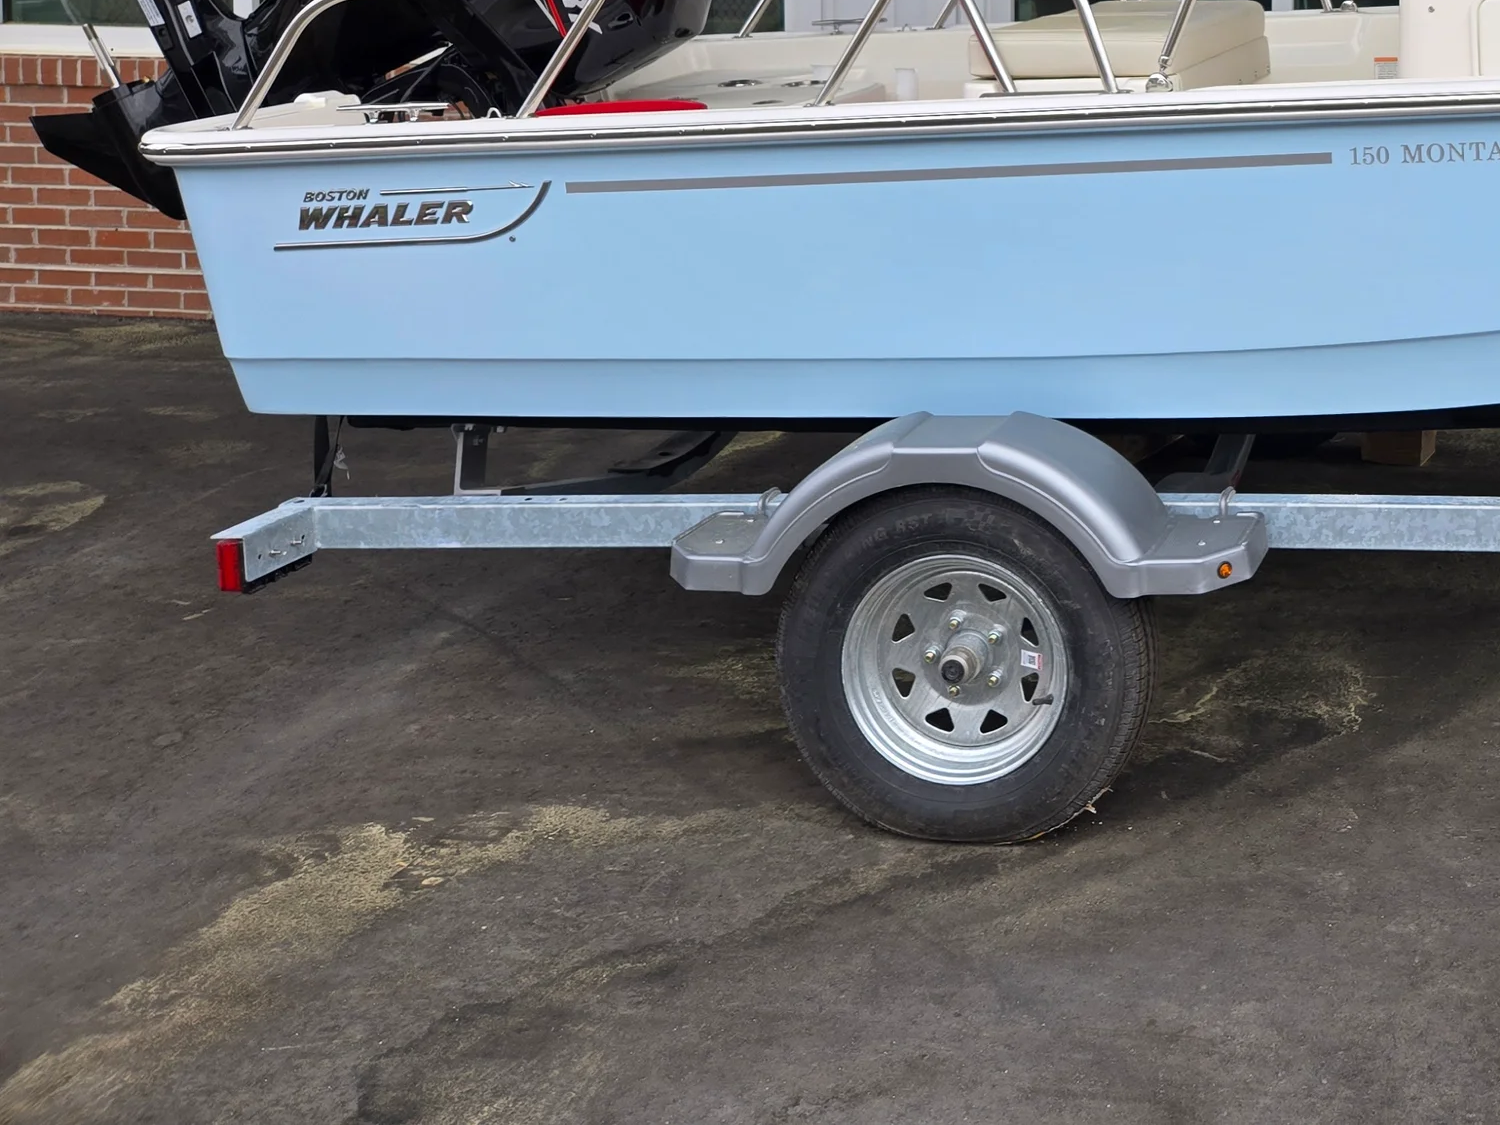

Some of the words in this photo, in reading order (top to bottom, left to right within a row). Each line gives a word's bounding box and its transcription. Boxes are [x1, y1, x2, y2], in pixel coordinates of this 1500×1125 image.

[1349, 146, 1390, 165] 150
[303, 188, 370, 203] BOSTON
[298, 200, 474, 231] WHALER
